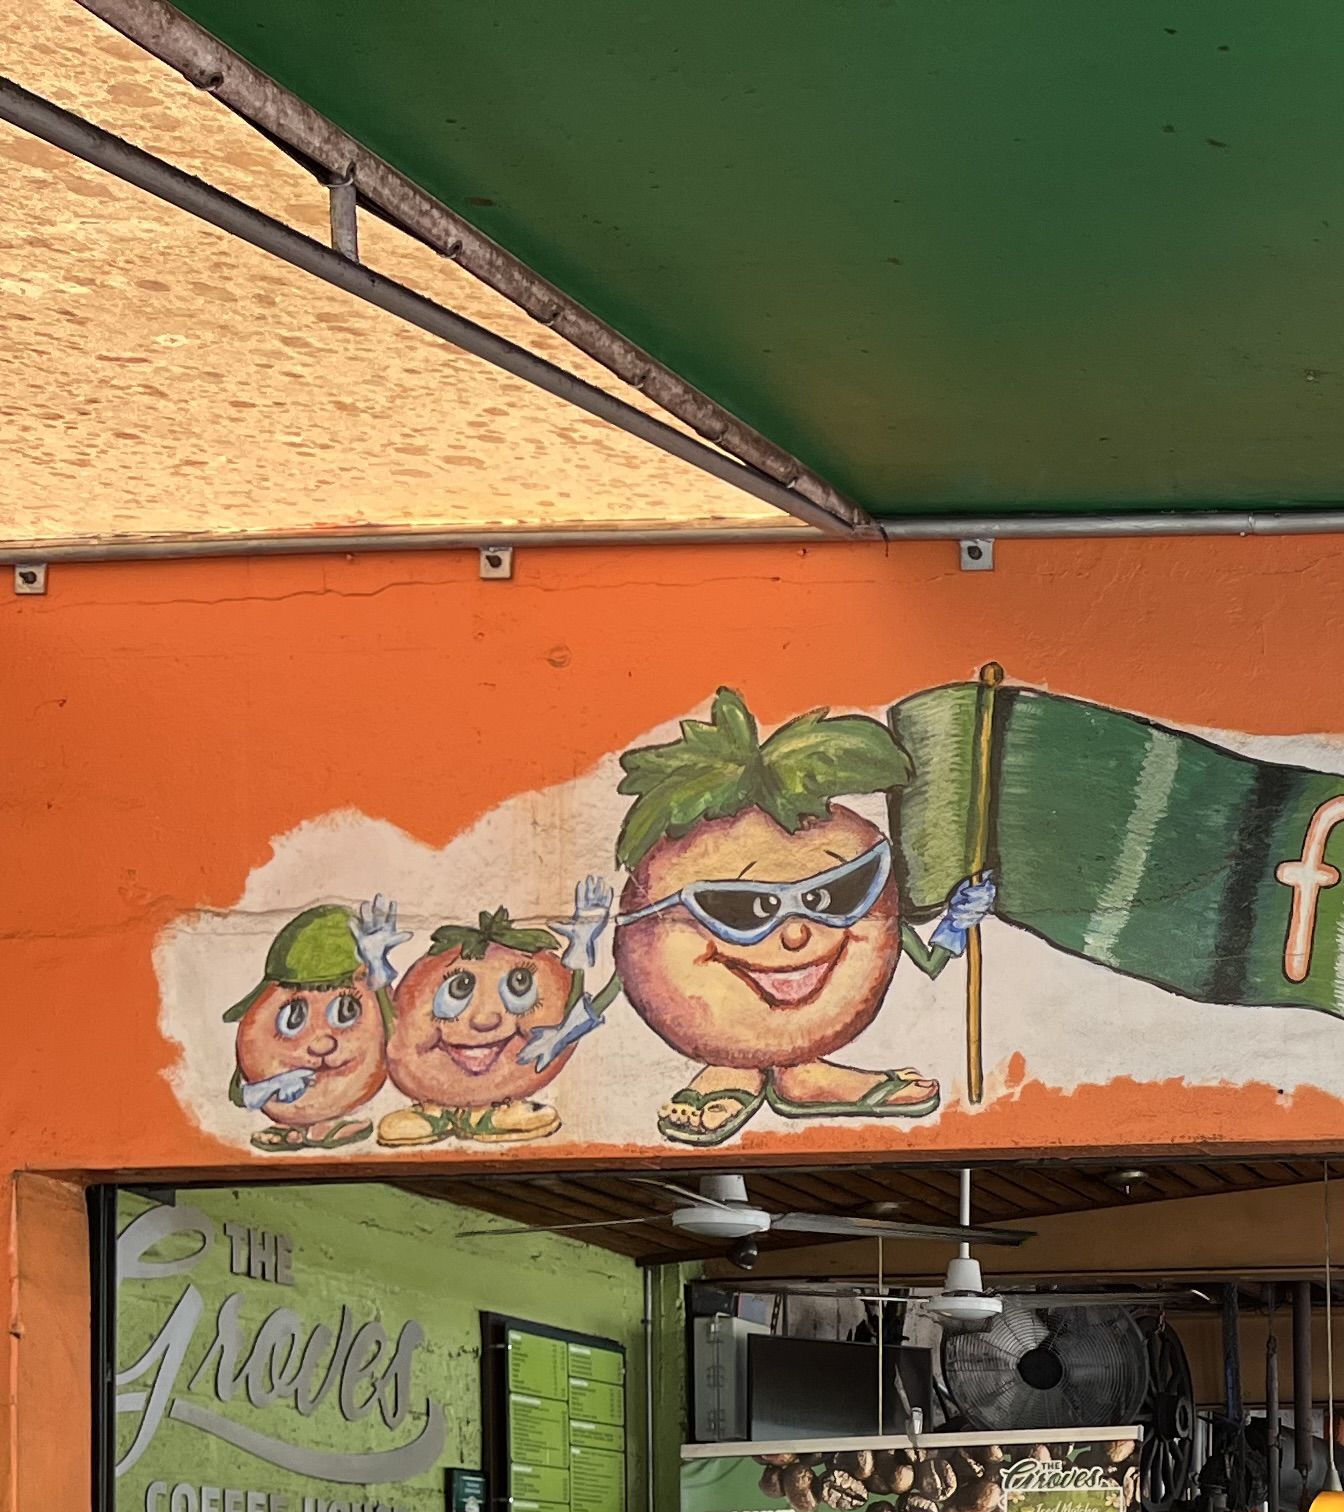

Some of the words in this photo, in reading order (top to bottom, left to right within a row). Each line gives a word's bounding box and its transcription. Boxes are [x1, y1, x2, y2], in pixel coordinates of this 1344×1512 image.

[223, 1222, 295, 1286] THE
[116, 1205, 446, 1484] Groves
[1041, 1462, 1061, 1470] THE
